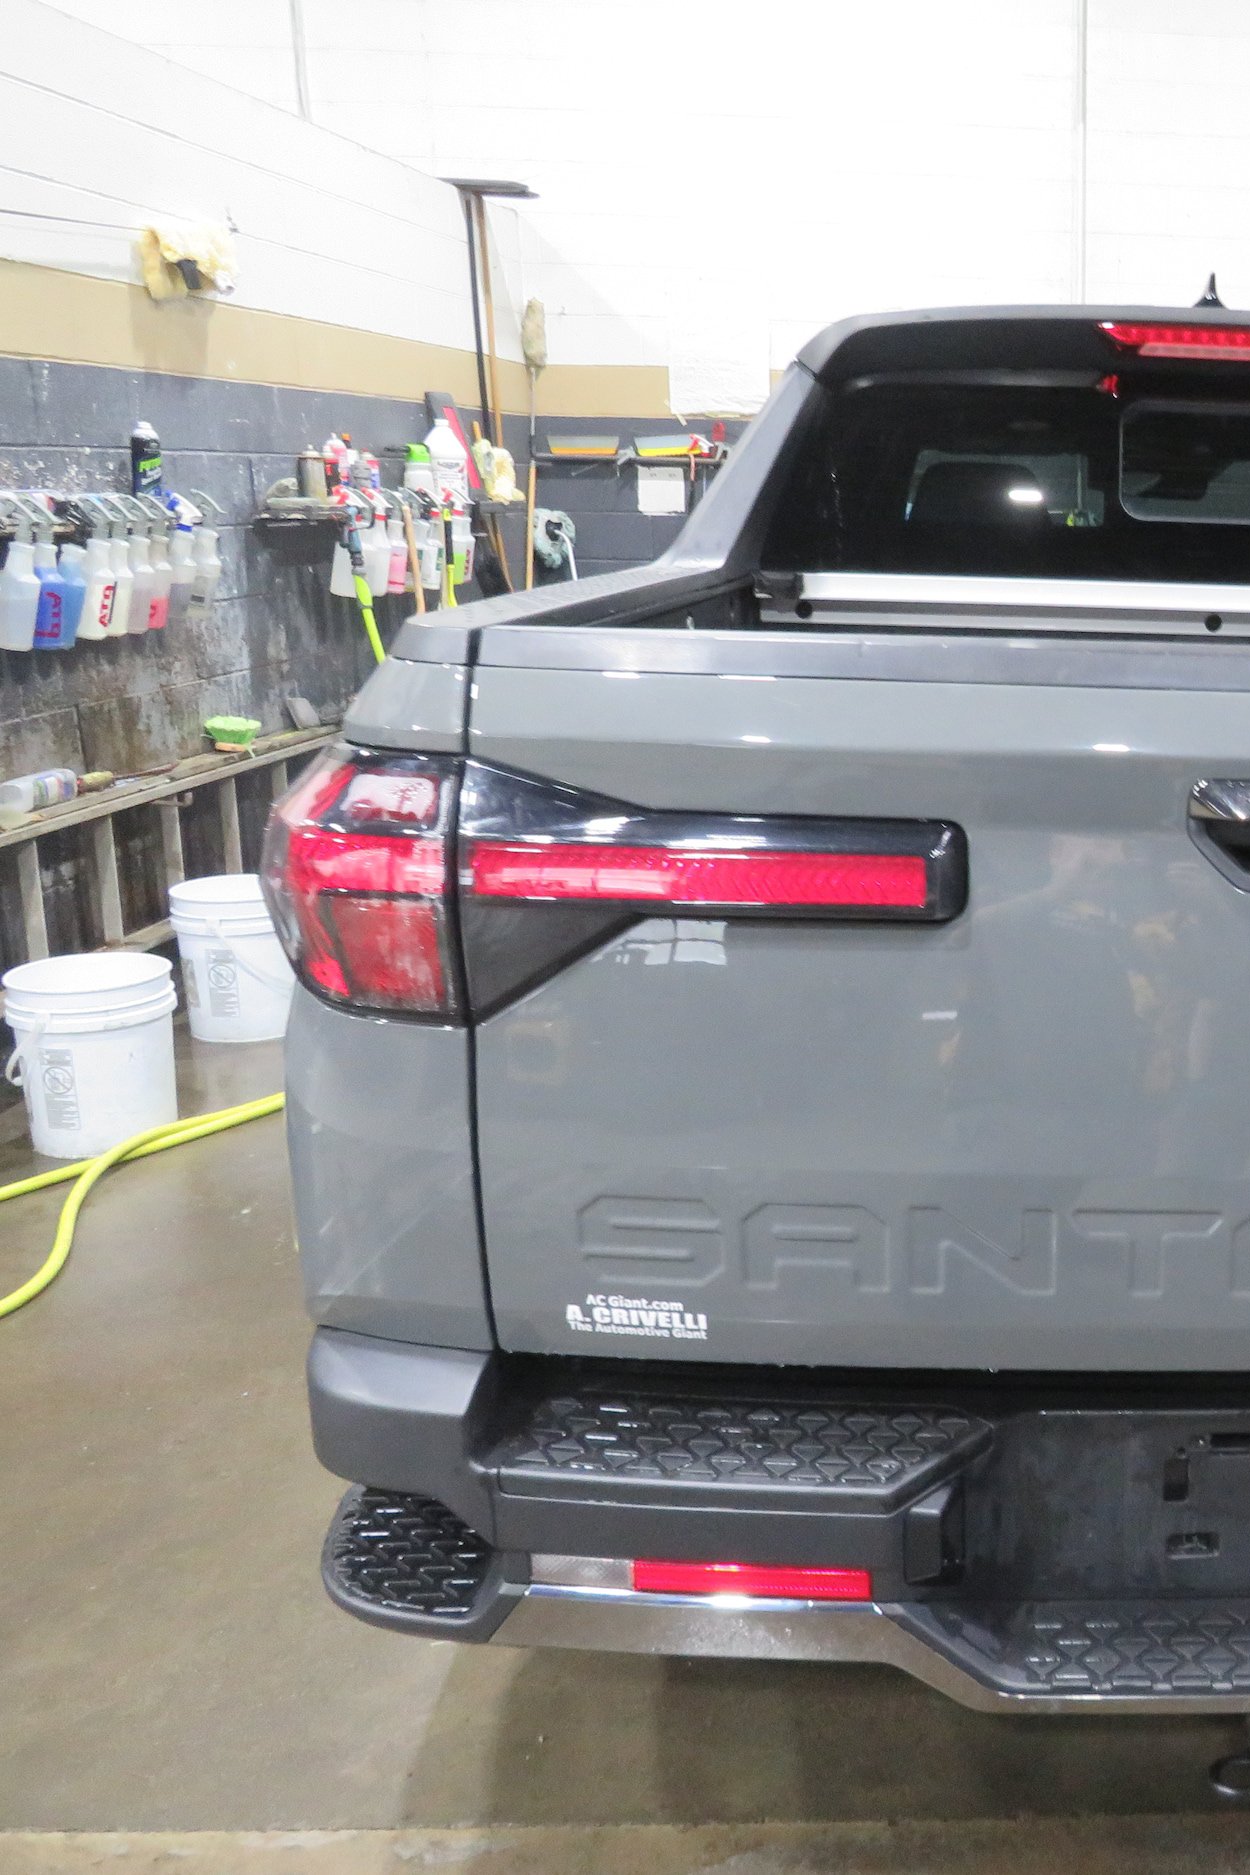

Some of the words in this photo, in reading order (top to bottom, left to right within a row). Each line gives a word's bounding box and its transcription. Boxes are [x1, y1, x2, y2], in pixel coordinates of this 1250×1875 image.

[565, 1304, 592, 1322] A.
[592, 1306, 708, 1330] CRIVELLI
[568, 1320, 593, 1332] The
[595, 1323, 670, 1337] Automotive
[672, 1328, 708, 1340] Giant
